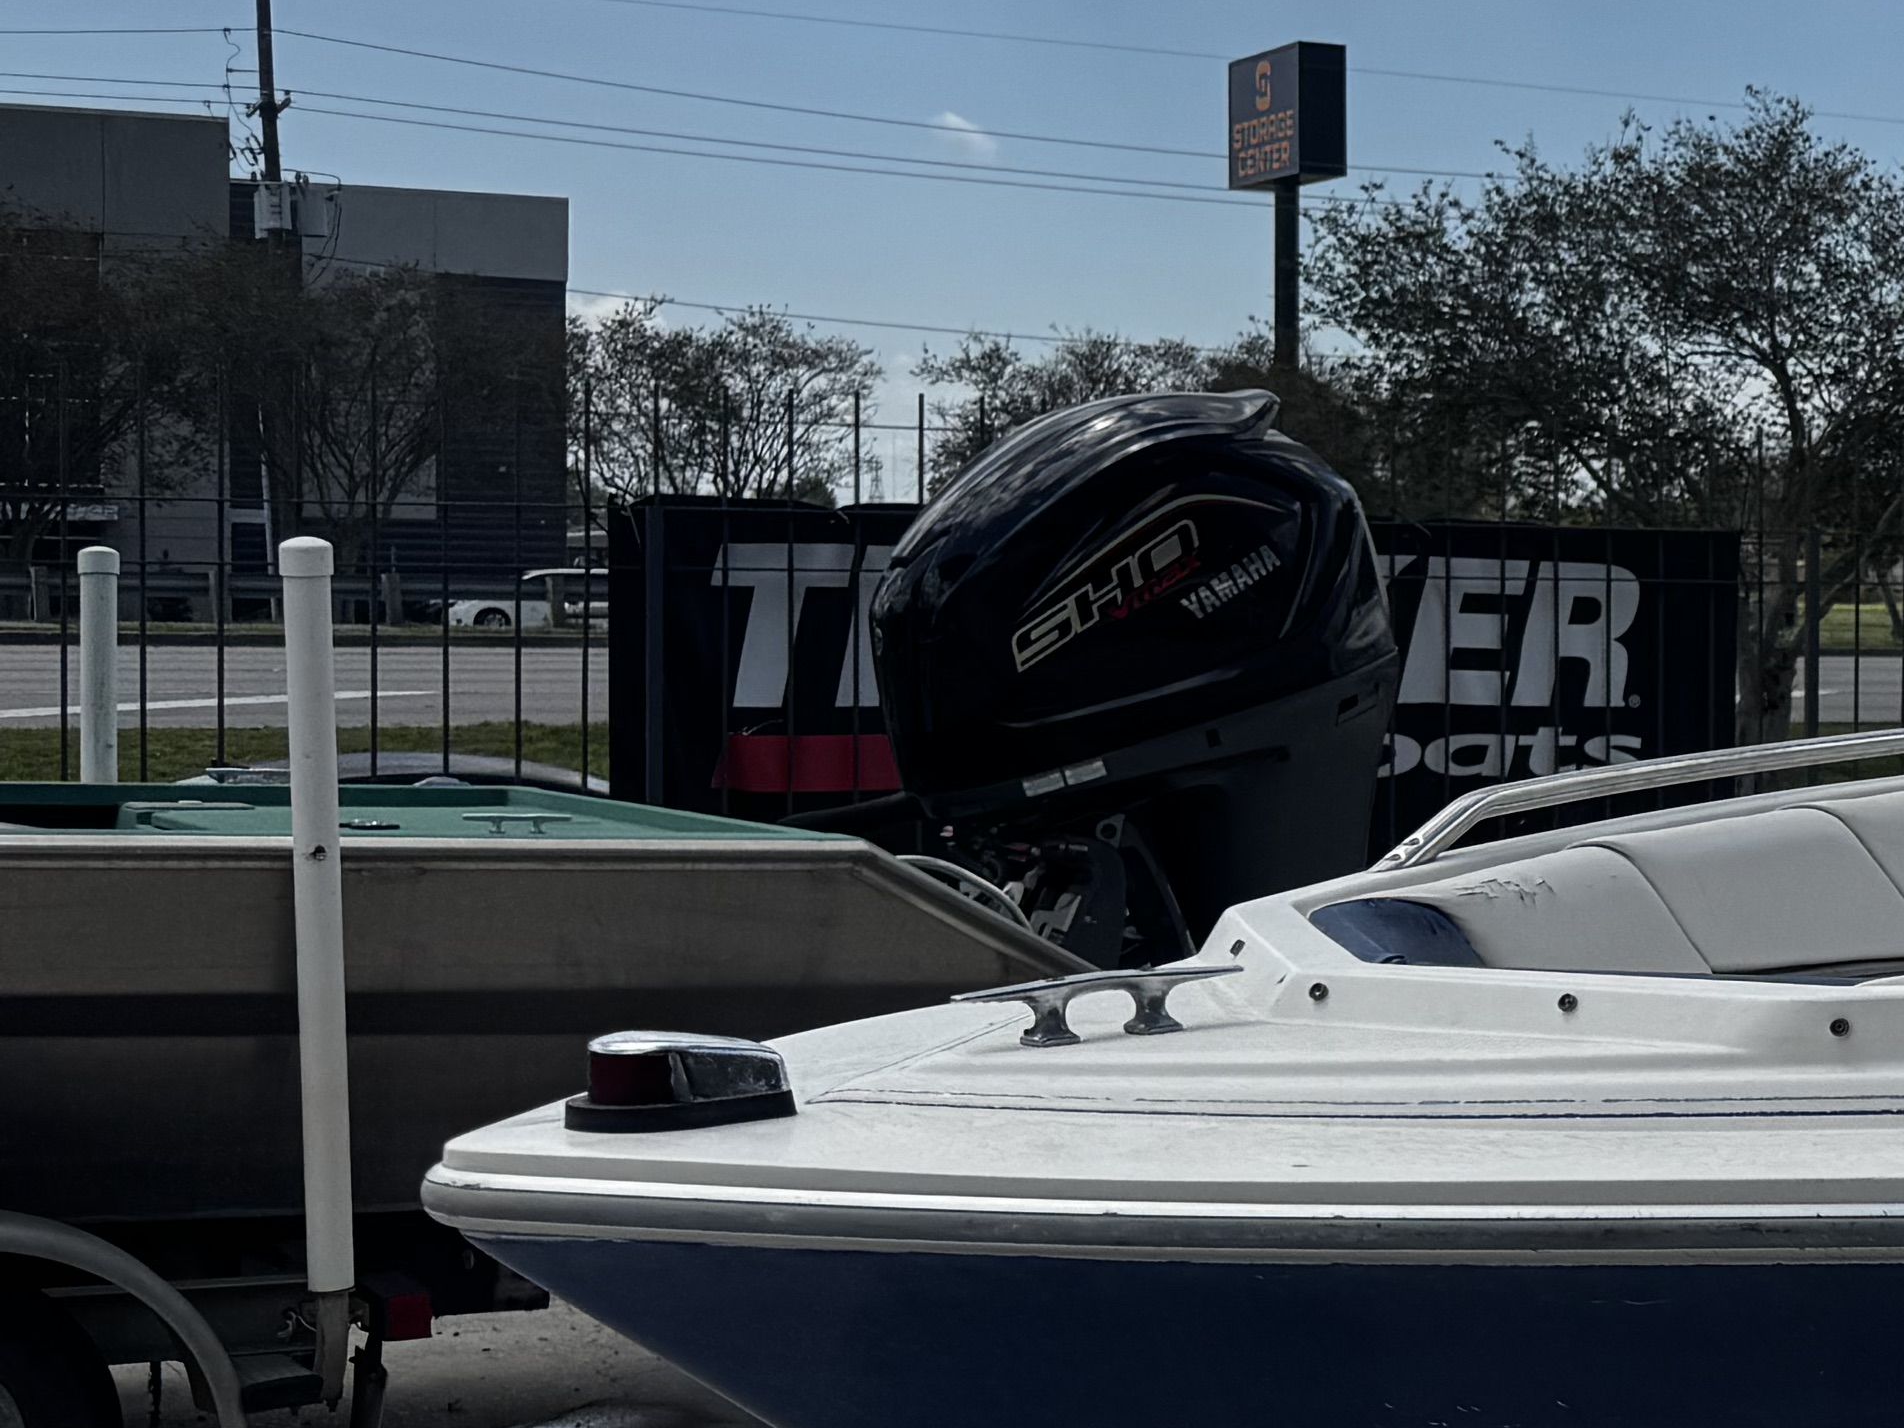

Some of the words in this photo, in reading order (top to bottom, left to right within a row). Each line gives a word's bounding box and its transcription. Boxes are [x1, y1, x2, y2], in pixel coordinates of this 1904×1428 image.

[1232, 110, 1295, 149] STORAGE
[1239, 141, 1290, 178] CENTER
[1012, 519, 1199, 672] SHO
[1180, 545, 1281, 619] YAMAHA
